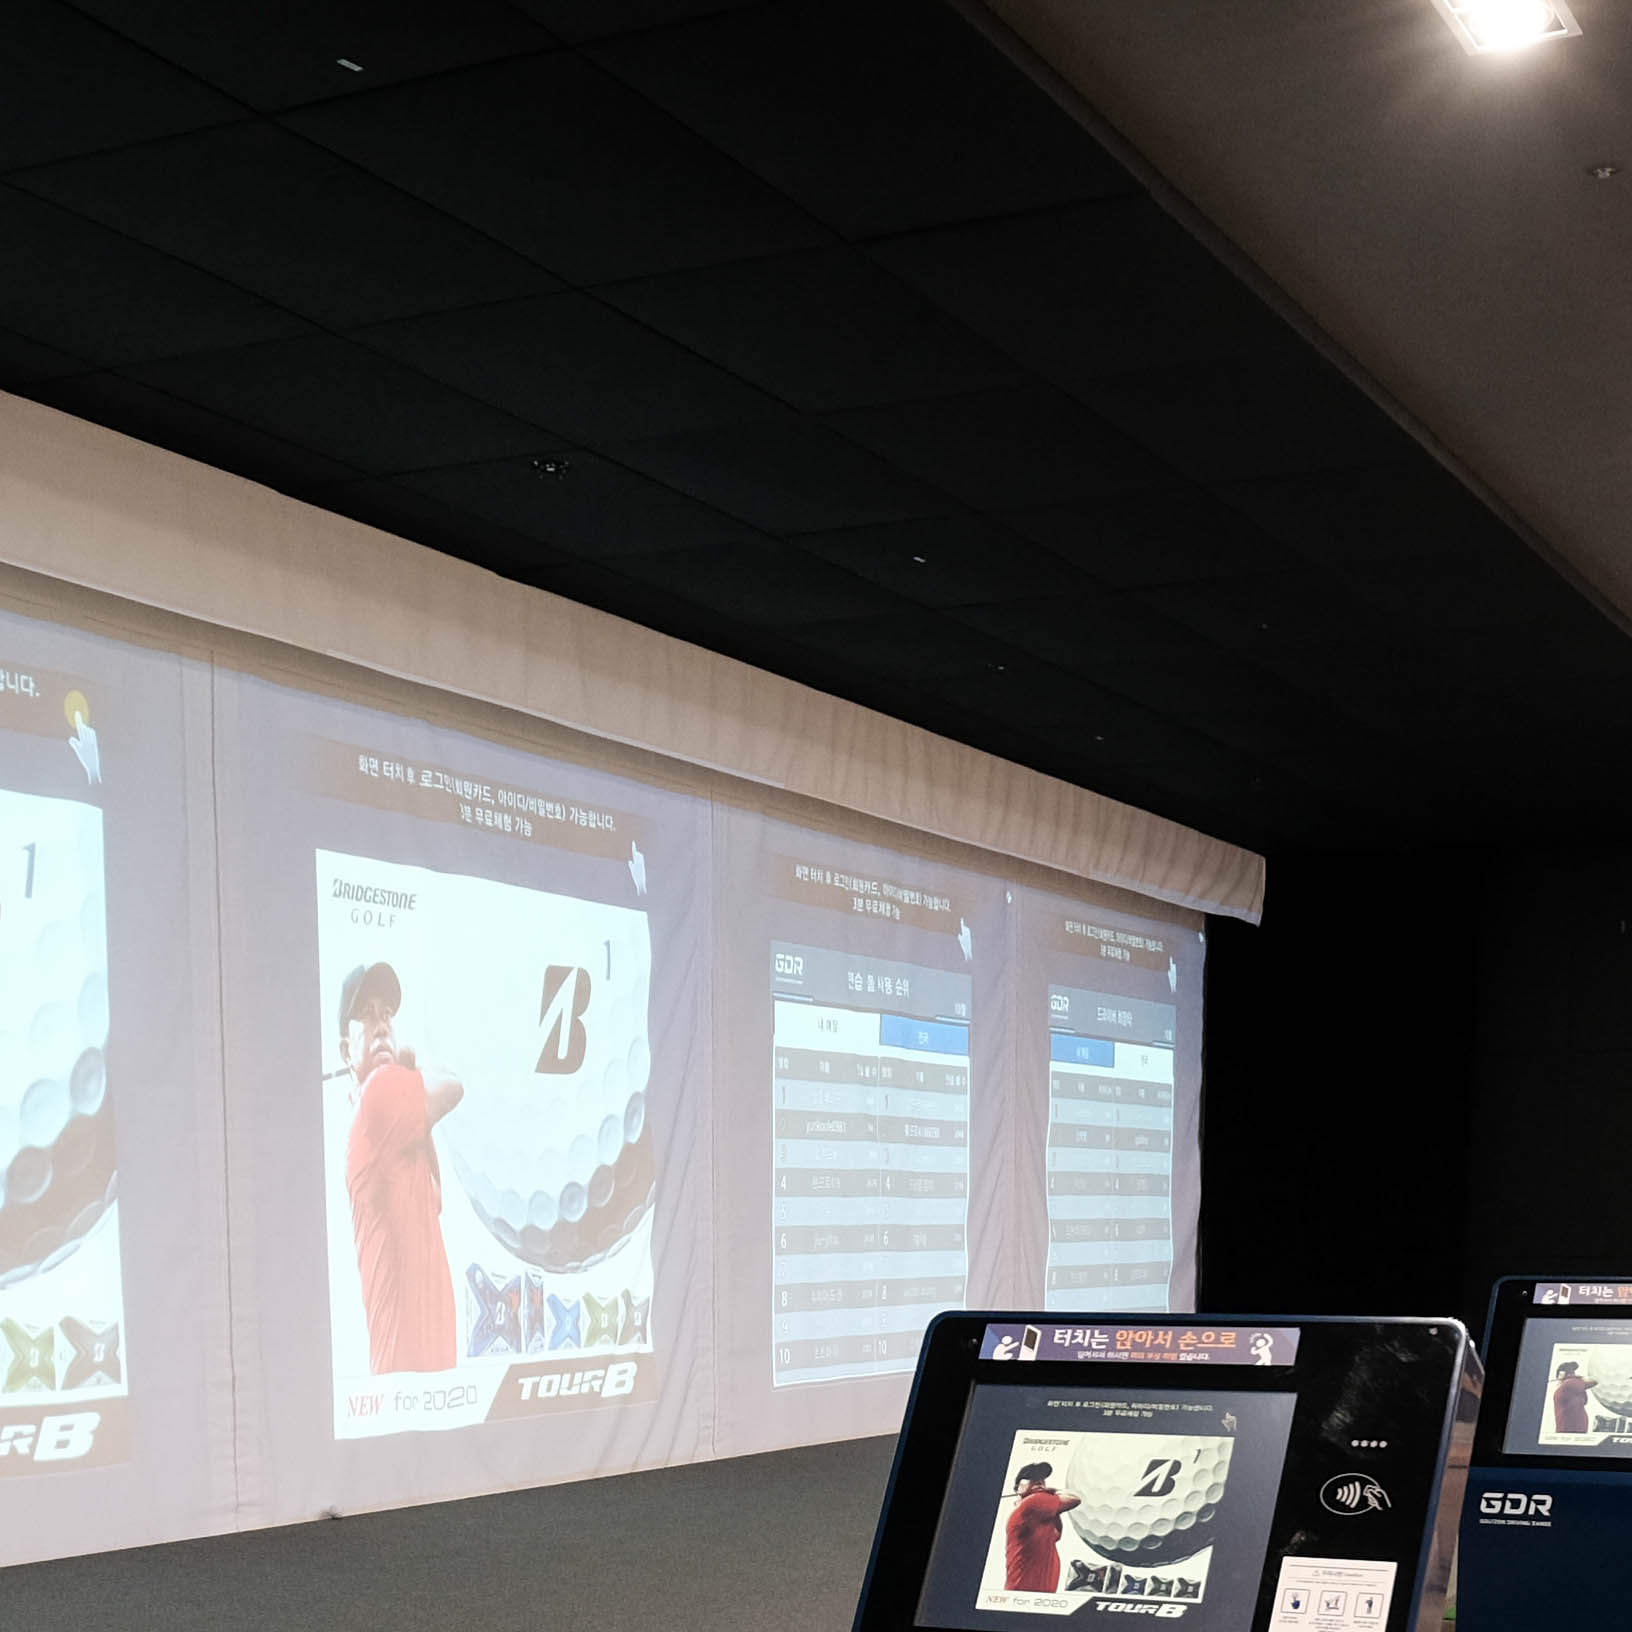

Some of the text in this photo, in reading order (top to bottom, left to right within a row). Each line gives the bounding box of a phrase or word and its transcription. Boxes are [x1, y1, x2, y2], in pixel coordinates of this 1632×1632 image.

[22, 842, 36, 899] 1
[332, 878, 417, 911] BRIDGESTONE
[350, 907, 396, 928] GOLF
[603, 940, 612, 981] 1
[775, 953, 804, 975] GDR
[1053, 1328, 1109, 1349] 터치는
[1177, 1330, 1237, 1350] 손으로
[347, 1384, 478, 1418] NEW for 2020
[1480, 1492, 1553, 1516] GDR
